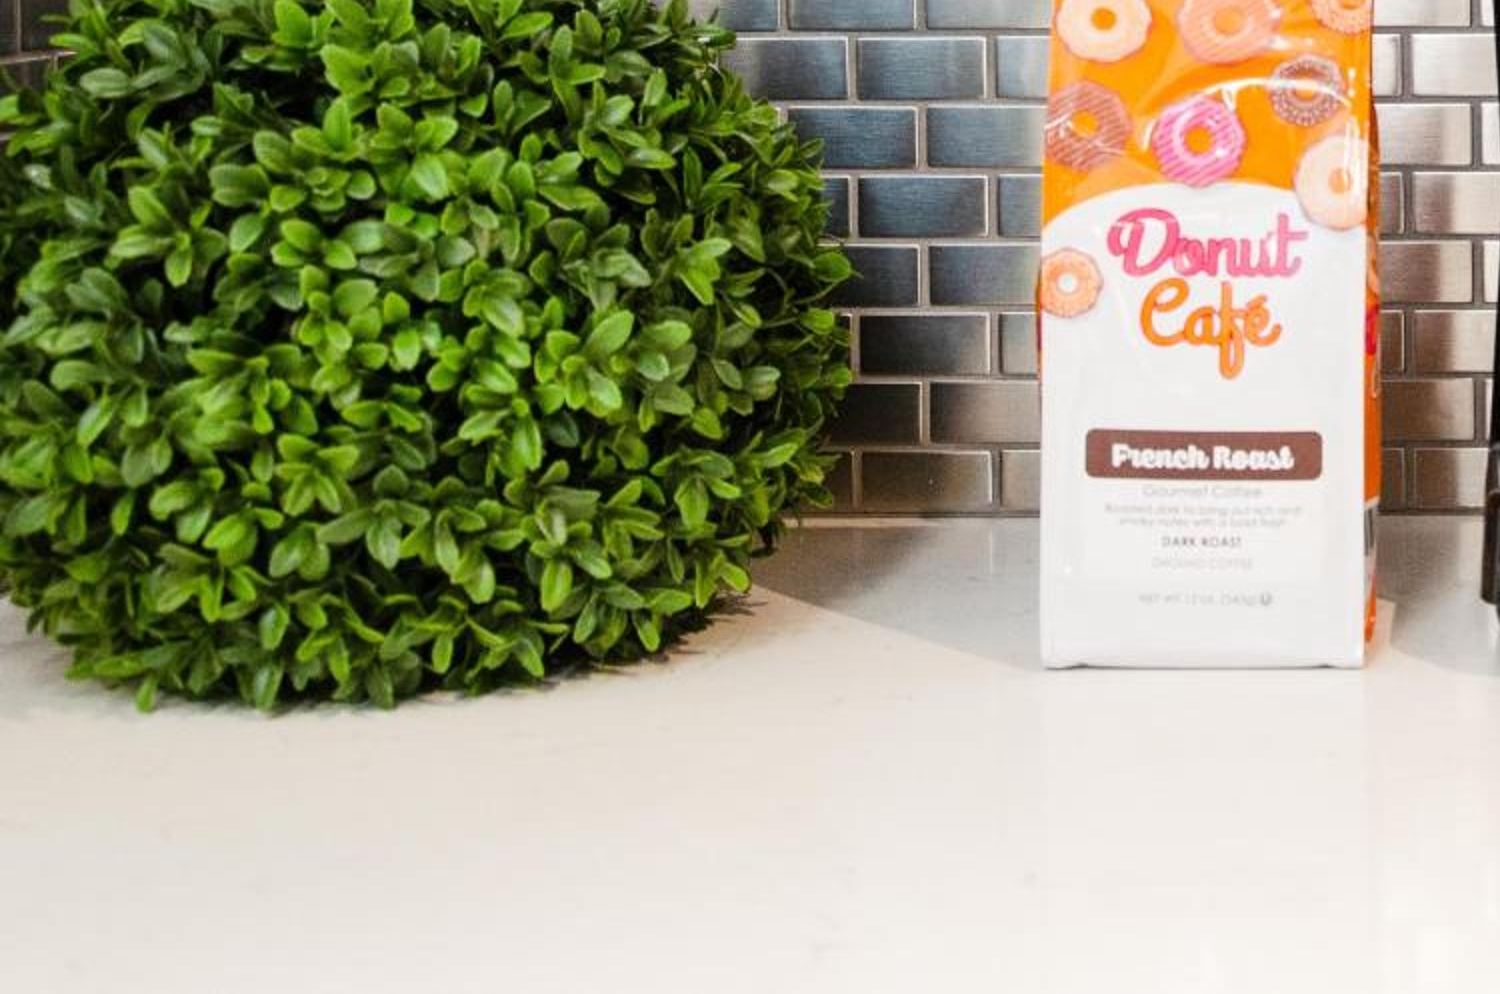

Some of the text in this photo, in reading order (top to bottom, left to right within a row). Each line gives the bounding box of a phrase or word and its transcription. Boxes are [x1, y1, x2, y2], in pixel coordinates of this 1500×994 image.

[1106, 207, 1309, 277] Donut
[1111, 443, 1295, 471] French Roast
[1161, 536, 1242, 548] DARK ROAST
